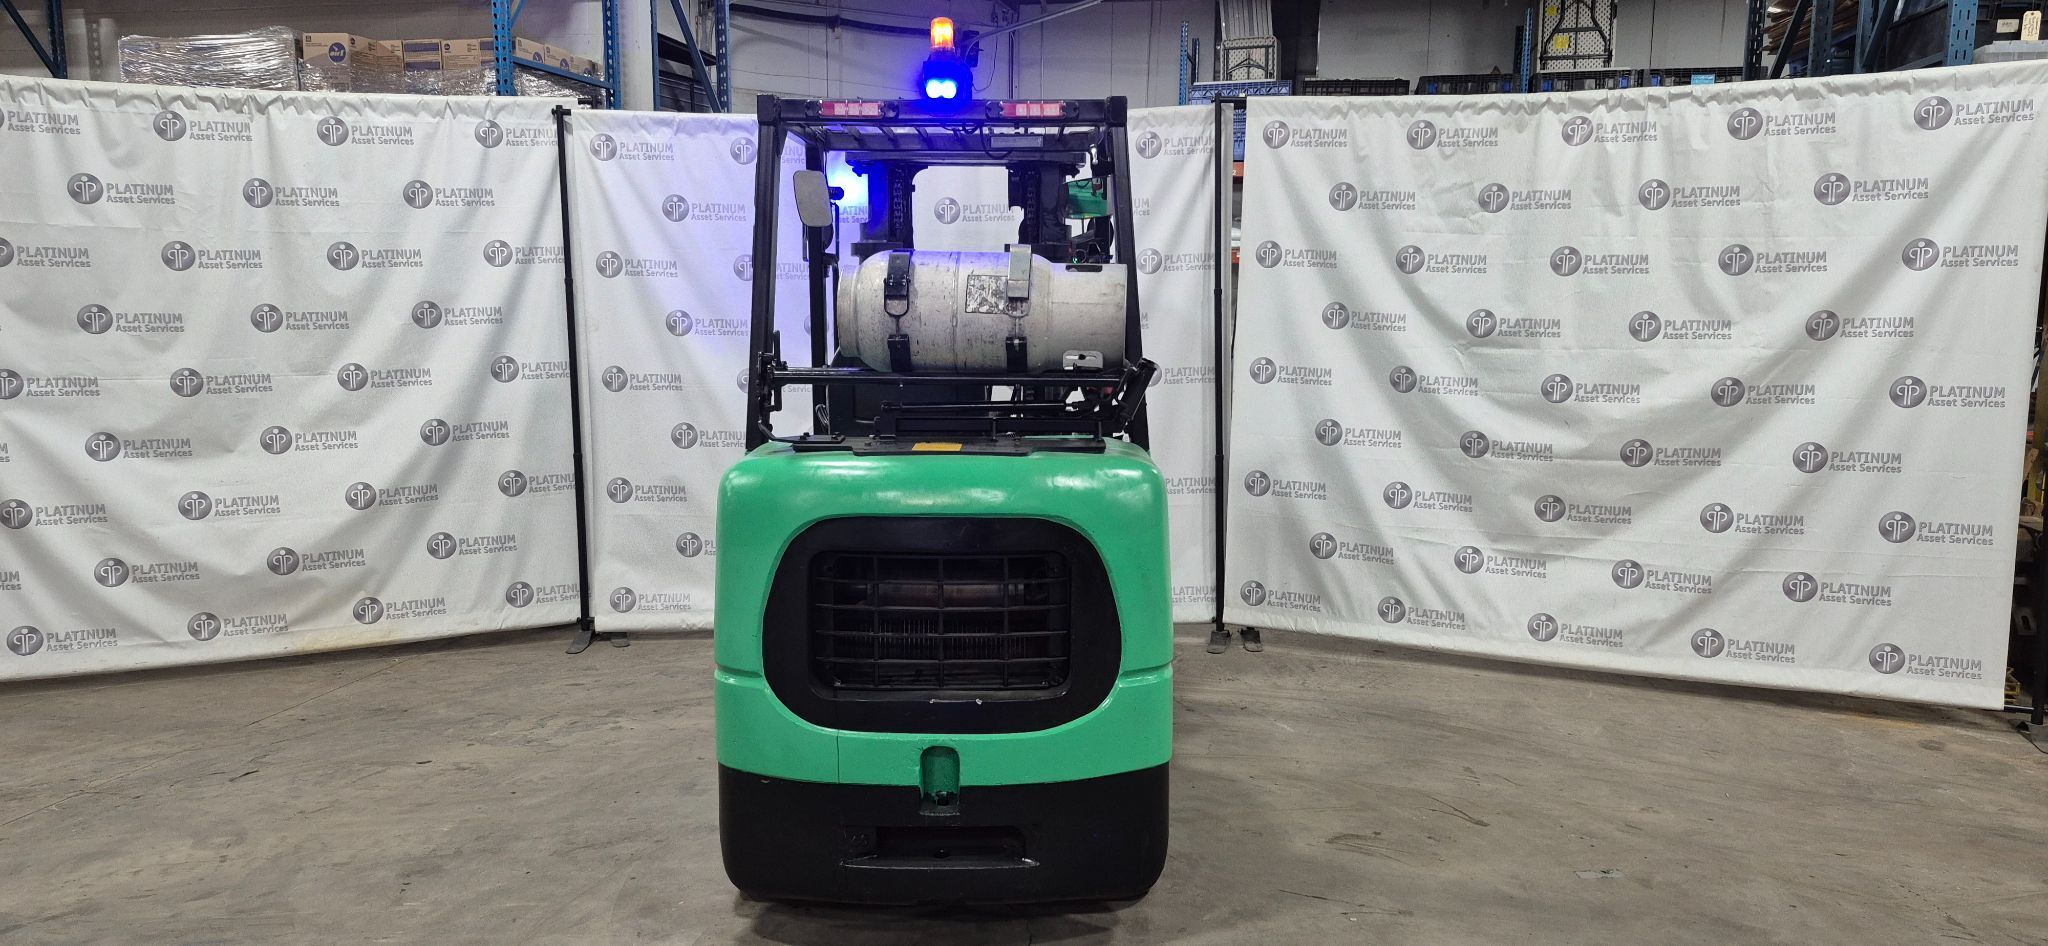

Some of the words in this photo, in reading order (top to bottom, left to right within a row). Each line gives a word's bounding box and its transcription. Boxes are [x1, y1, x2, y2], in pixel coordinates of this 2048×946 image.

[1956, 98, 2034, 117] PLATINUM
[7, 110, 79, 127] PLATINUM
[1766, 112, 1836, 128] PLATINUM
[1953, 115, 1985, 127] Asset
[1988, 111, 2034, 124] Services
[7, 122, 36, 133] Asset
[38, 124, 81, 135] Services
[351, 125, 412, 138] PLATINUM
[1292, 128, 1347, 140] PLATINUM
[1764, 126, 1792, 137] Asset
[1794, 124, 1836, 135] Services
[351, 136, 376, 145] Asset
[377, 136, 414, 145] Services
[1290, 139, 1313, 148] Asset
[1314, 139, 1347, 148] Services
[620, 141, 673, 154] PLATINUM
[619, 152, 640, 160] Asset
[642, 152, 675, 161] Services
[106, 182, 174, 196] PLATINUM
[1853, 177, 1929, 194] PLATINUM
[275, 186, 338, 199] PLATINUM
[1511, 189, 1571, 203] PLATINUM
[1673, 185, 1740, 200] PLATINUM
[1852, 192, 1881, 202] Asset
[1884, 190, 1929, 201] Services
[106, 195, 135, 204] Asset
[136, 196, 176, 205] Services
[275, 198, 300, 207] Asset
[301, 198, 340, 207] Services
[1510, 202, 1533, 211] Asset
[1533, 201, 1572, 210] Services
[1671, 198, 1698, 208] Asset
[1700, 197, 1741, 207] Services
[691, 202, 745, 215] PLATINUM
[691, 213, 713, 221] Asset
[714, 213, 746, 222] Services
[17, 246, 89, 260] PLATINUM
[198, 249, 261, 261] PLATINUM
[361, 248, 422, 261] PLATINUM
[1756, 251, 1827, 265] PLATINUM
[1942, 244, 2018, 259] PLATINUM
[16, 258, 46, 267] Asset
[48, 259, 91, 268] Services
[197, 261, 224, 269] Asset
[225, 261, 263, 269] Services
[361, 260, 386, 268] Asset
[388, 259, 423, 268] Services
[624, 258, 677, 271] PLATINUM
[1427, 253, 1487, 267] PLATINUM
[1584, 254, 1649, 266] PLATINUM
[1940, 258, 1970, 268] Asset
[1972, 257, 2018, 267] Services
[624, 268, 644, 277] Asset
[646, 269, 678, 278] Services
[1425, 264, 1449, 273] Asset
[1451, 265, 1487, 274] Services
[1582, 266, 1609, 275] Asset
[1610, 266, 1650, 275] Services
[1754, 264, 1783, 274] Asset
[1785, 263, 1828, 273] Services
[115, 312, 183, 325] PLATINUM
[285, 311, 348, 323] PLATINUM
[1499, 317, 1561, 330] PLATINUM
[1842, 316, 1914, 330] PLATINUM
[115, 324, 143, 333] Asset
[144, 324, 185, 333] Services
[285, 322, 310, 331] Asset
[312, 322, 350, 330] Services
[1664, 319, 1731, 332] PLATINUM
[1497, 329, 1522, 337] Asset
[1524, 329, 1561, 338] Services
[1662, 332, 1689, 340] Asset
[1691, 332, 1732, 340] Services
[1840, 329, 1869, 338] Asset
[1871, 329, 1914, 338] Services
[205, 373, 272, 388] PLATINUM
[370, 367, 431, 381] PLATINUM
[629, 373, 682, 385] PLATINUM
[370, 380, 395, 389] Asset
[397, 378, 433, 388] Services
[629, 383, 651, 391] Asset
[652, 383, 683, 391] Services
[1418, 374, 1478, 389] PLATINUM
[206, 385, 233, 395] Asset
[234, 384, 273, 394] Services
[1418, 385, 1441, 395] Asset
[1443, 387, 1478, 397] Services
[1575, 382, 1640, 396] PLATINUM
[1748, 384, 1815, 396] PLATINUM
[1929, 385, 2005, 399] PLATINUM
[1573, 393, 1600, 403] Asset
[1602, 394, 1640, 404] Services
[1745, 395, 1772, 405] Asset
[1774, 395, 1815, 405] Services
[1927, 397, 1958, 407] Asset
[1960, 398, 2005, 408] Services
[295, 430, 357, 444] PLATINUM
[123, 437, 191, 451] PLATINUM
[294, 442, 320, 452] Asset
[322, 440, 359, 451] Services
[123, 450, 150, 459] Asset
[152, 449, 193, 458] Services
[1655, 447, 1721, 459] PLATINUM
[1830, 450, 1902, 465] PLATINUM
[1653, 458, 1681, 466] Asset
[1682, 458, 1722, 467] Services
[1828, 462, 1857, 472] Asset
[1859, 463, 1902, 474] Services
[635, 484, 686, 496] PLATINUM
[1272, 478, 1326, 494] PLATINUM
[1271, 489, 1292, 498] Asset
[1294, 491, 1327, 501] Services
[215, 494, 279, 510] PLATINUM
[35, 503, 106, 519] PLATINUM
[214, 508, 241, 517] Asset
[242, 505, 281, 516] Services
[1568, 503, 1632, 518] PLATINUM
[35, 517, 64, 527] Asset
[66, 514, 108, 525] Services
[1566, 514, 1592, 523] Asset
[1594, 515, 1632, 525] Services
[1736, 513, 1804, 528] PLATINUM
[1734, 525, 1762, 534] Asset
[1764, 526, 1804, 536] Services
[1918, 521, 1993, 537] PLATINUM
[1916, 533, 1946, 543] Asset
[1949, 535, 1994, 546] Services
[301, 548, 364, 565] PLATINUM
[131, 561, 198, 576] PLATINUM
[301, 561, 327, 572] Asset
[328, 558, 366, 569] Services
[131, 574, 158, 584] Asset
[160, 572, 200, 582] Services
[1646, 569, 1711, 587] PLATINUM
[1644, 580, 1671, 591] Asset
[1673, 583, 1712, 595] Services
[1820, 581, 1891, 599] PLATINUM
[1818, 593, 1847, 604] Asset
[1849, 595, 1892, 607] Services
[1727, 638, 1795, 656] PLATINUM
[1725, 649, 1753, 660] Asset
[1755, 652, 1796, 664] Services
[1908, 653, 1982, 672] PLATINUM
[1906, 665, 1936, 677] Asset
[1938, 668, 1982, 681] Services
